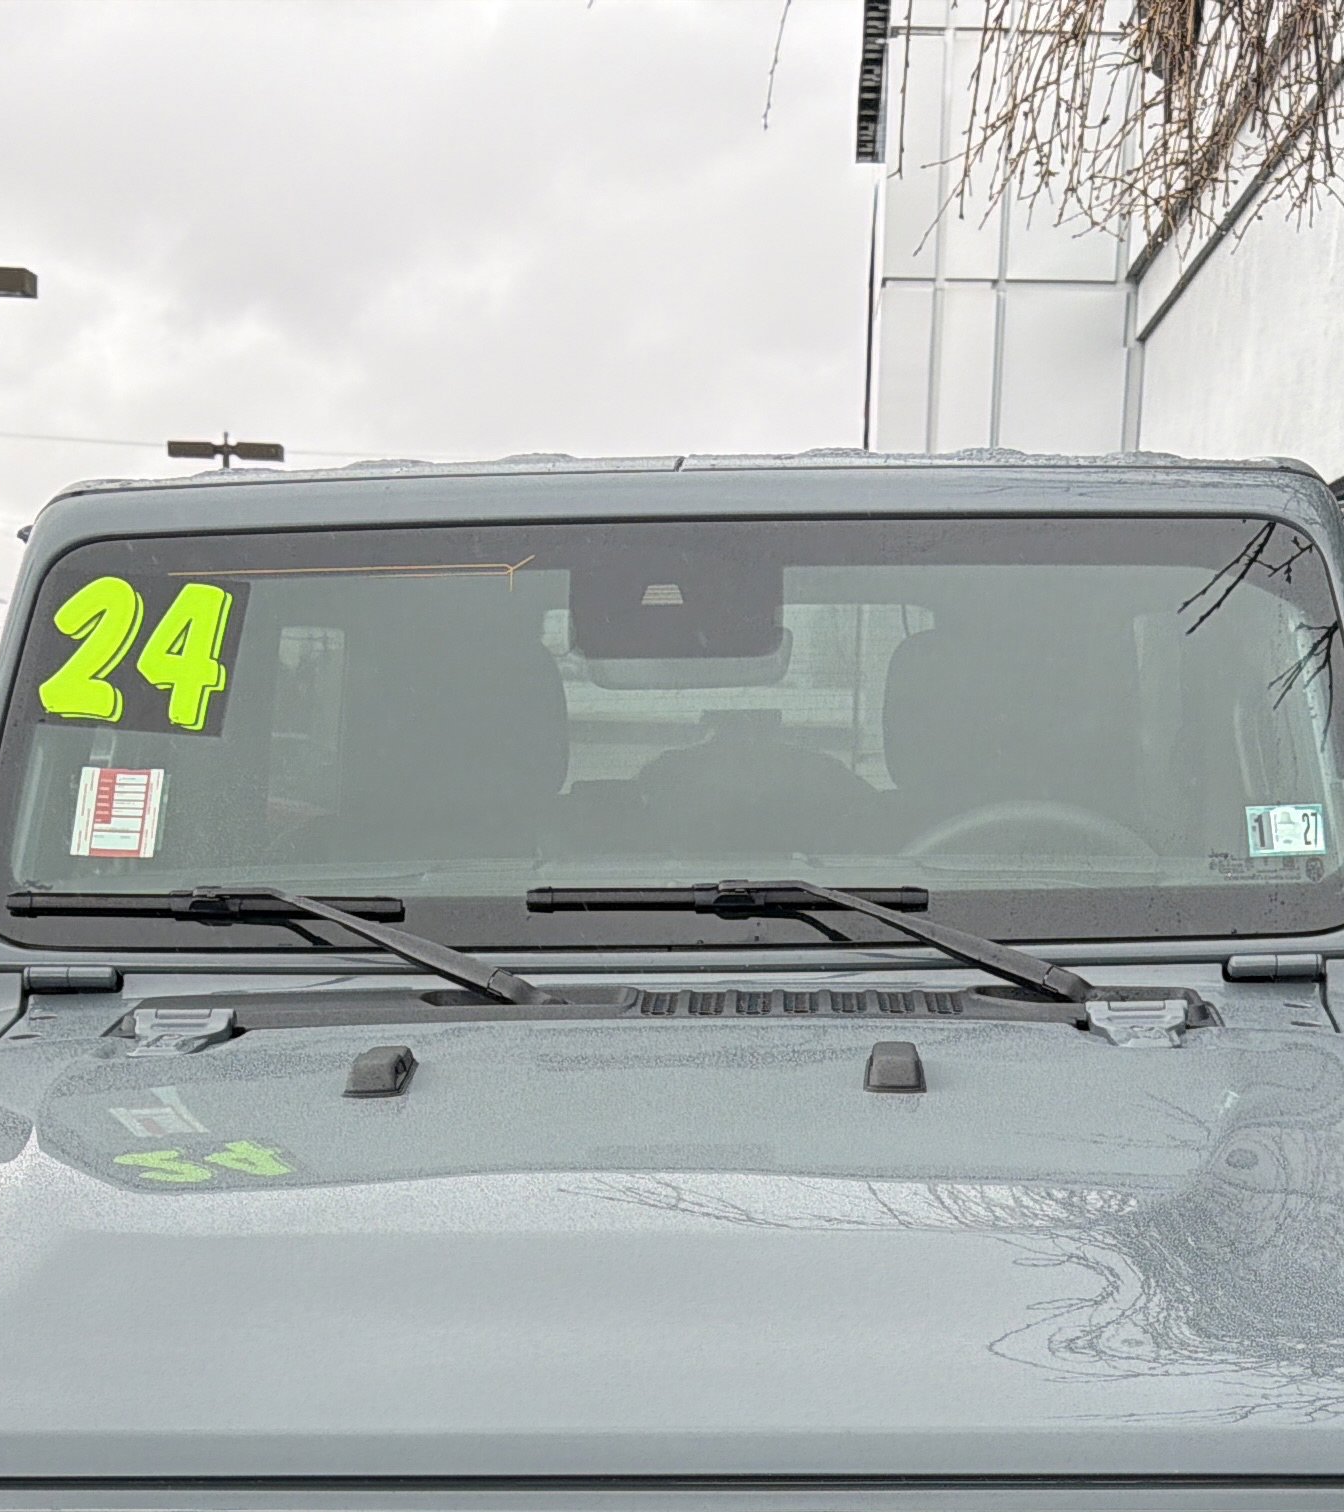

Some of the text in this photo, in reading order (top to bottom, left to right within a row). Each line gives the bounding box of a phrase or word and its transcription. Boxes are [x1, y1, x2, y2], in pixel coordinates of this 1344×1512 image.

[39, 576, 233, 731] 24
[1253, 814, 1266, 848] 1
[1301, 812, 1318, 848] 27
